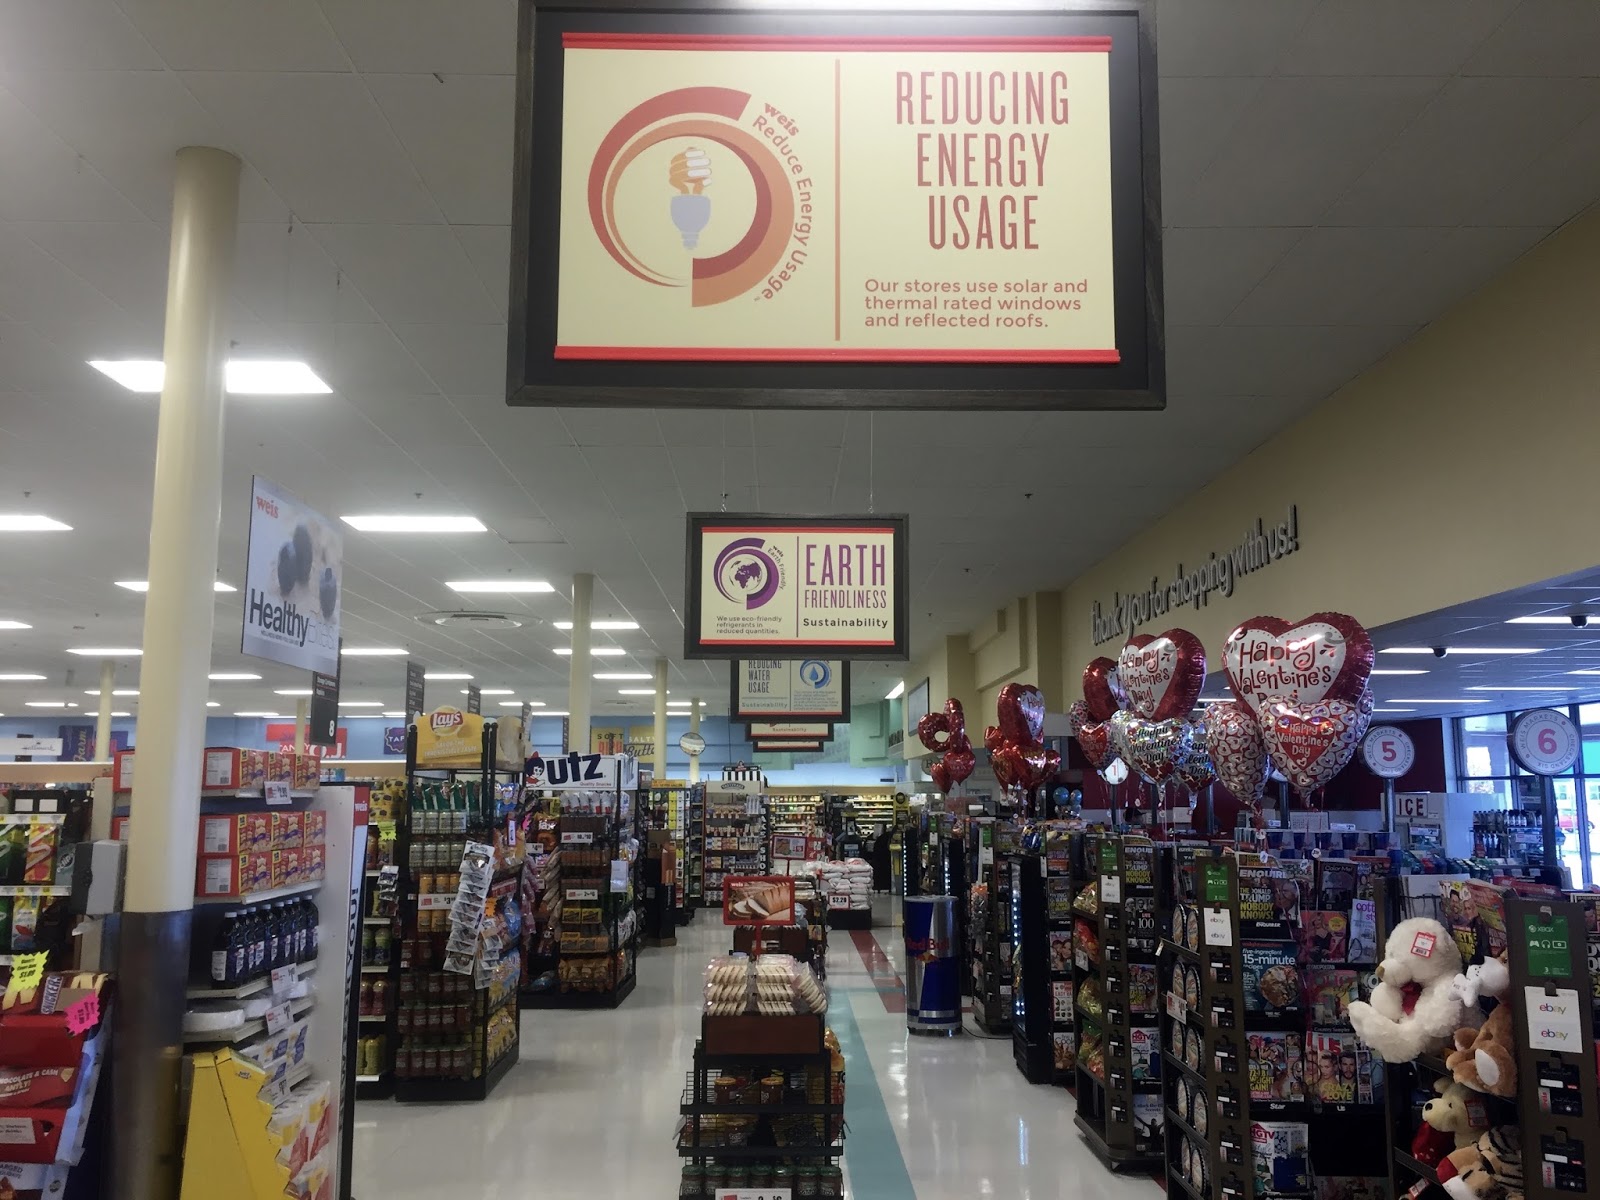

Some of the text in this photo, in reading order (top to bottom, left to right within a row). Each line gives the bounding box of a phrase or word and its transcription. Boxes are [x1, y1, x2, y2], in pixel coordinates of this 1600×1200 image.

[896, 71, 1069, 125] REDUCING
[764, 103, 799, 136] weis
[917, 133, 1049, 187] ENERGY
[752, 115, 813, 300] Reduce Energy Usage
[929, 195, 1039, 250] USAGE
[865, 279, 1088, 293] Our stores use solar and
[865, 296, 1081, 310] thermal rated windows
[865, 313, 1048, 327] and reflected roofs.
[256, 495, 278, 519] weis
[768, 548, 787, 590] Earth Friendly
[806, 544, 885, 586] EARTH
[1092, 504, 1299, 646] thank you for shopping with us!
[804, 590, 887, 608] FRIENDLINESS
[250, 588, 308, 647] Healthy
[742, 616, 782, 624] eco-friendly
[803, 618, 888, 629] Sustainability
[1239, 638, 1316, 671] Happy
[749, 660, 782, 668] REDUCING
[748, 670, 771, 680] WATER
[748, 682, 770, 693] USAGE
[329, 720, 335, 737] 8
[1290, 724, 1318, 735] Happy
[1523, 714, 1558, 733] MARKETS
[1277, 732, 1329, 747] Valentine's
[1538, 729, 1557, 755] 6
[279, 743, 311, 753] CANY
[1292, 745, 1311, 758] Day
[1382, 741, 1396, 762] 5
[1399, 798, 1424, 816] ICE
[1240, 902, 1274, 911] NOBODY
[1356, 903, 1375, 913] cott
[1240, 910, 1274, 920] KNOWS!
[1137, 918, 1154, 929] 100
[1242, 954, 1296, 965] 15-minute
[41, 976, 63, 1014] SNICKERS
[1540, 1003, 1566, 1014] ebay
[1541, 1029, 1568, 1040] ebay
[1323, 1083, 1355, 1092] CRAZY
[1327, 1091, 1353, 1101] LOVE
[1270, 1102, 1286, 1110] Star
[1250, 1127, 1275, 1139] HGTV
